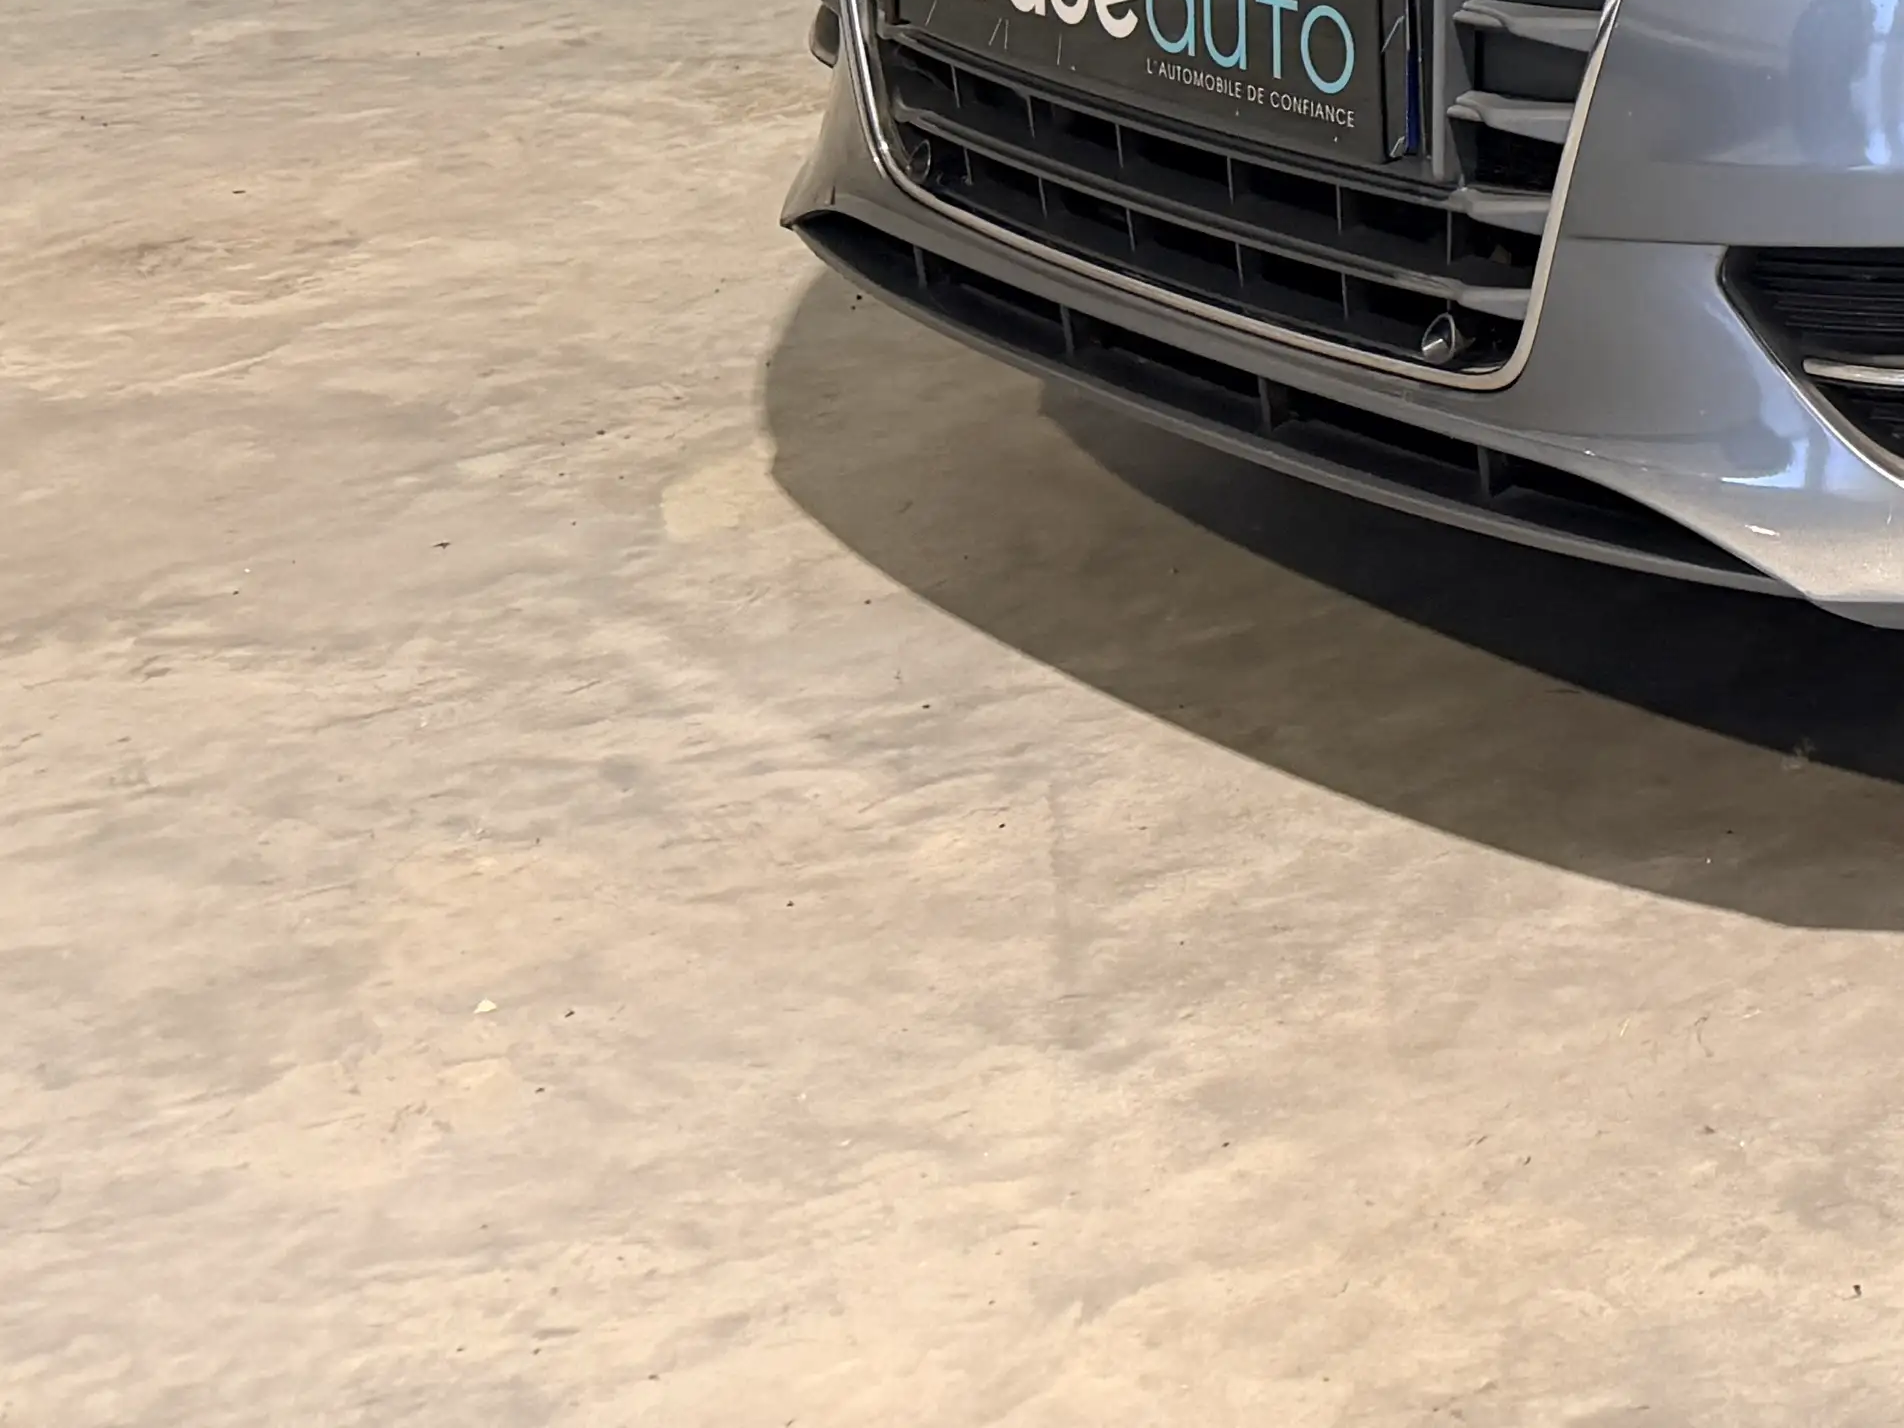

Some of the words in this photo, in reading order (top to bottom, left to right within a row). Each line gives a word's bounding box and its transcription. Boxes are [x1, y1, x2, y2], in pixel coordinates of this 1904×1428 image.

[1146, 58, 1242, 99] L'AUTOMOBILE
[1247, 84, 1265, 105] DE
[1270, 91, 1355, 128] CONFIANCE
